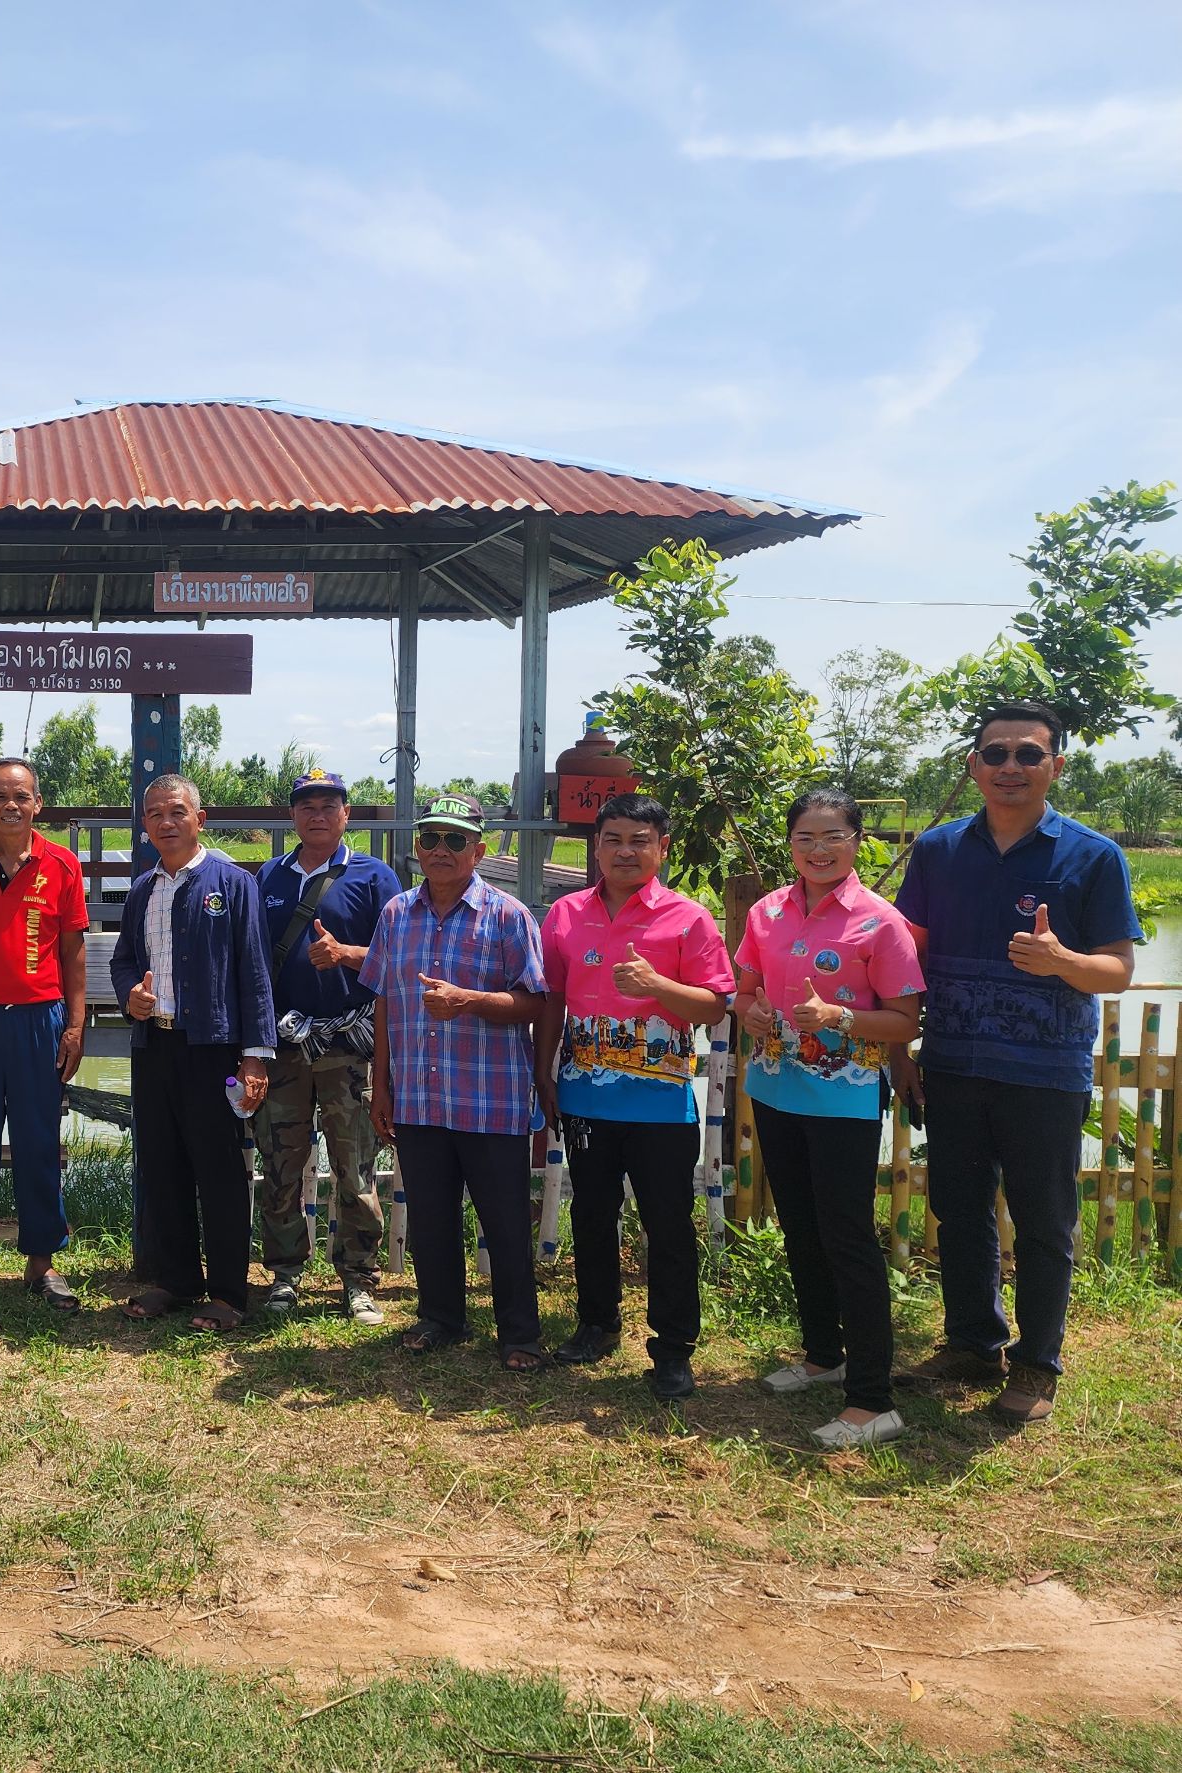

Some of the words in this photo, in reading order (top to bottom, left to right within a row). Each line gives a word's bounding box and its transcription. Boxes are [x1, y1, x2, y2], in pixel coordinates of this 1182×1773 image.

[162, 572, 309, 603] เถียงนาพึงพอใจ
[89, 678, 122, 690] 35130
[430, 798, 471, 817] VANS
